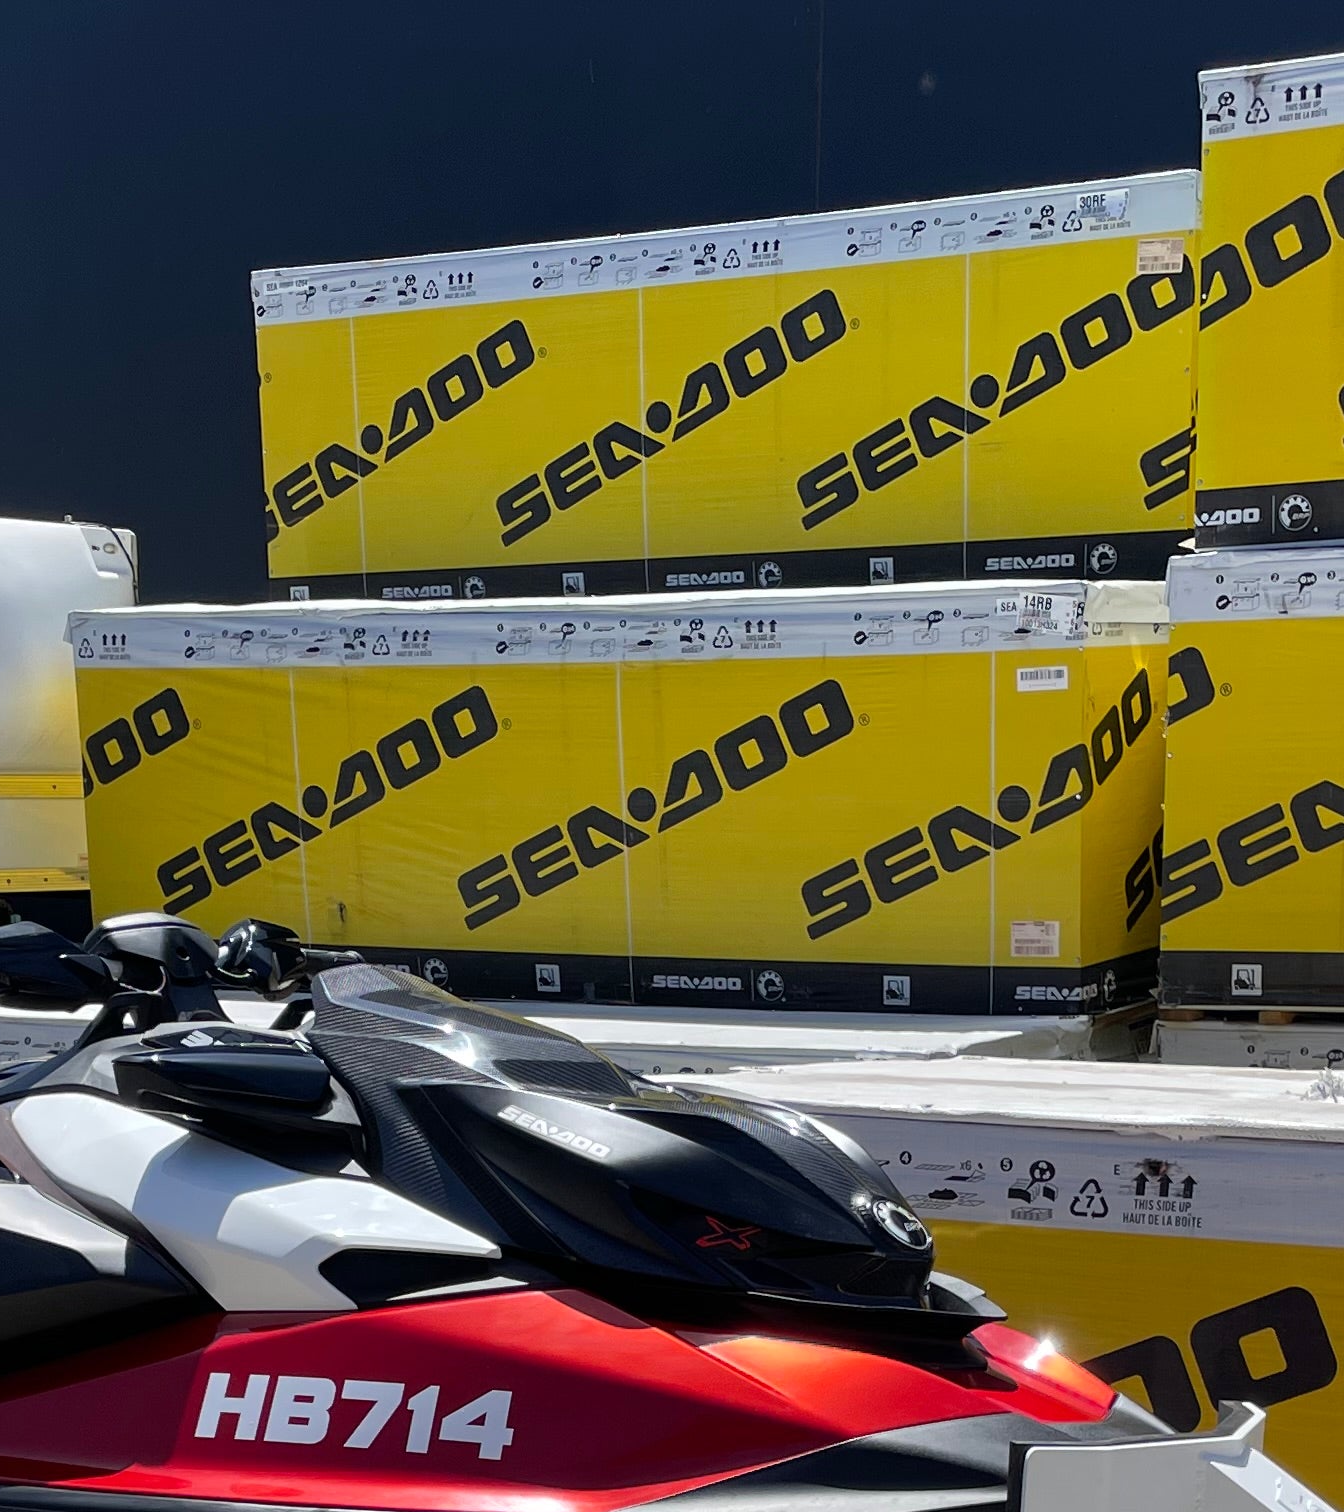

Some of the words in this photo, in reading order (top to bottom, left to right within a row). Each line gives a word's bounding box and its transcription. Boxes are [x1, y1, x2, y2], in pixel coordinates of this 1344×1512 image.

[1134, 1198, 1154, 1211] THIS
[1157, 1200, 1176, 1212] SIDE
[1179, 1202, 1192, 1213] UP
[1122, 1212, 1145, 1225] HAUT
[1148, 1214, 1159, 1225] DE
[1161, 1215, 1172, 1226] LA
[195, 1373, 515, 1461] HB714
